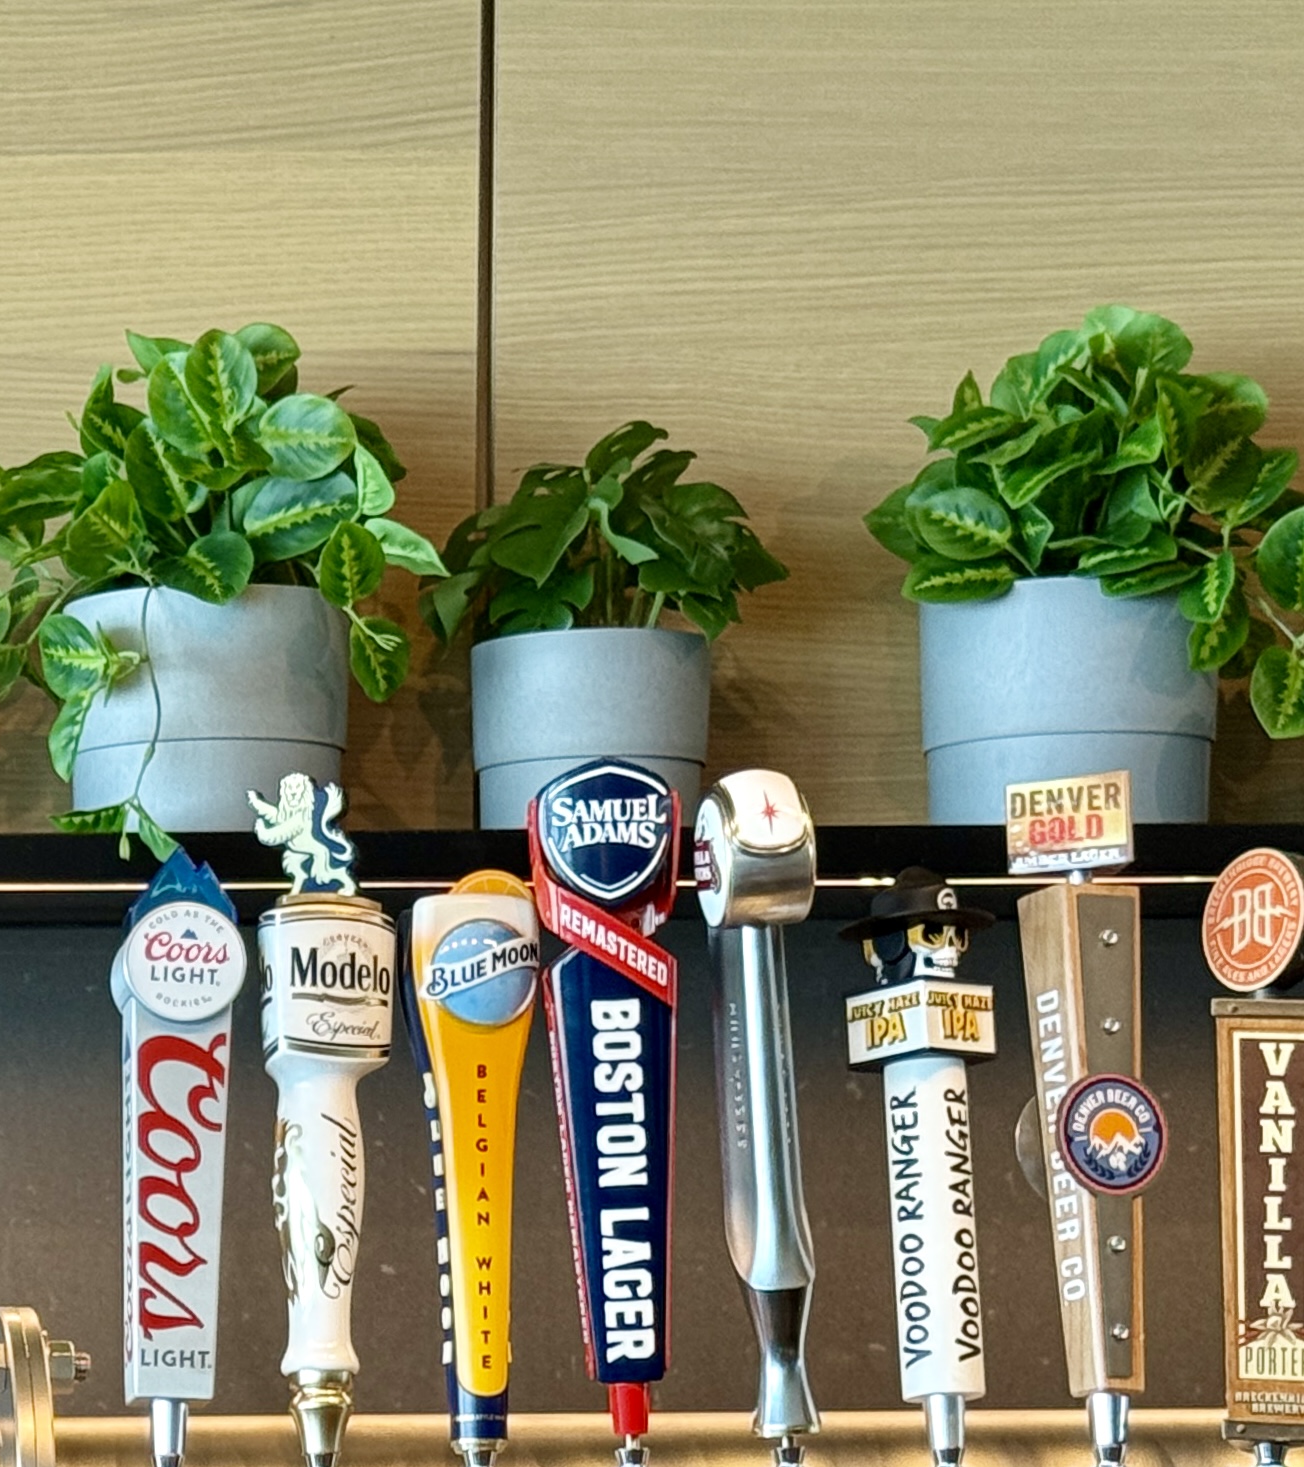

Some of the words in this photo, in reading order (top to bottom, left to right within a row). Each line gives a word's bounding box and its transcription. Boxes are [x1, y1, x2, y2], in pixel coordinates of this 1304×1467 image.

[552, 794, 667, 827] SAMUEL
[1011, 782, 1121, 819] DENVER
[560, 822, 657, 852] ADAMS
[1028, 814, 1104, 846] GOLD
[144, 931, 230, 965] Coors
[290, 947, 390, 995] Modelo
[426, 958, 488, 998] BLUE
[492, 942, 538, 973] MOON
[560, 906, 668, 987] REMASTERED
[150, 965, 219, 985] LIGHT
[306, 1011, 379, 1041] Especial
[866, 1012, 908, 1051] IPA
[942, 1009, 980, 1041] IPA
[591, 998, 649, 1188] BOSTON
[1072, 1090, 1105, 1132] DENVER
[1135, 1105, 1150, 1123] CO
[476, 1064, 490, 1226] BELGIAN
[890, 1085, 924, 1223] RANGER
[943, 1087, 974, 1218] RANGER
[138, 1033, 227, 1341] Coors
[1259, 1042, 1296, 1308] VANILLA
[600, 1207, 657, 1364] LAGER
[900, 1233, 933, 1369] VOODOO
[952, 1228, 982, 1362] VOODOO
[476, 1258, 492, 1369] WHITE
[141, 1349, 212, 1368] LIGHT
